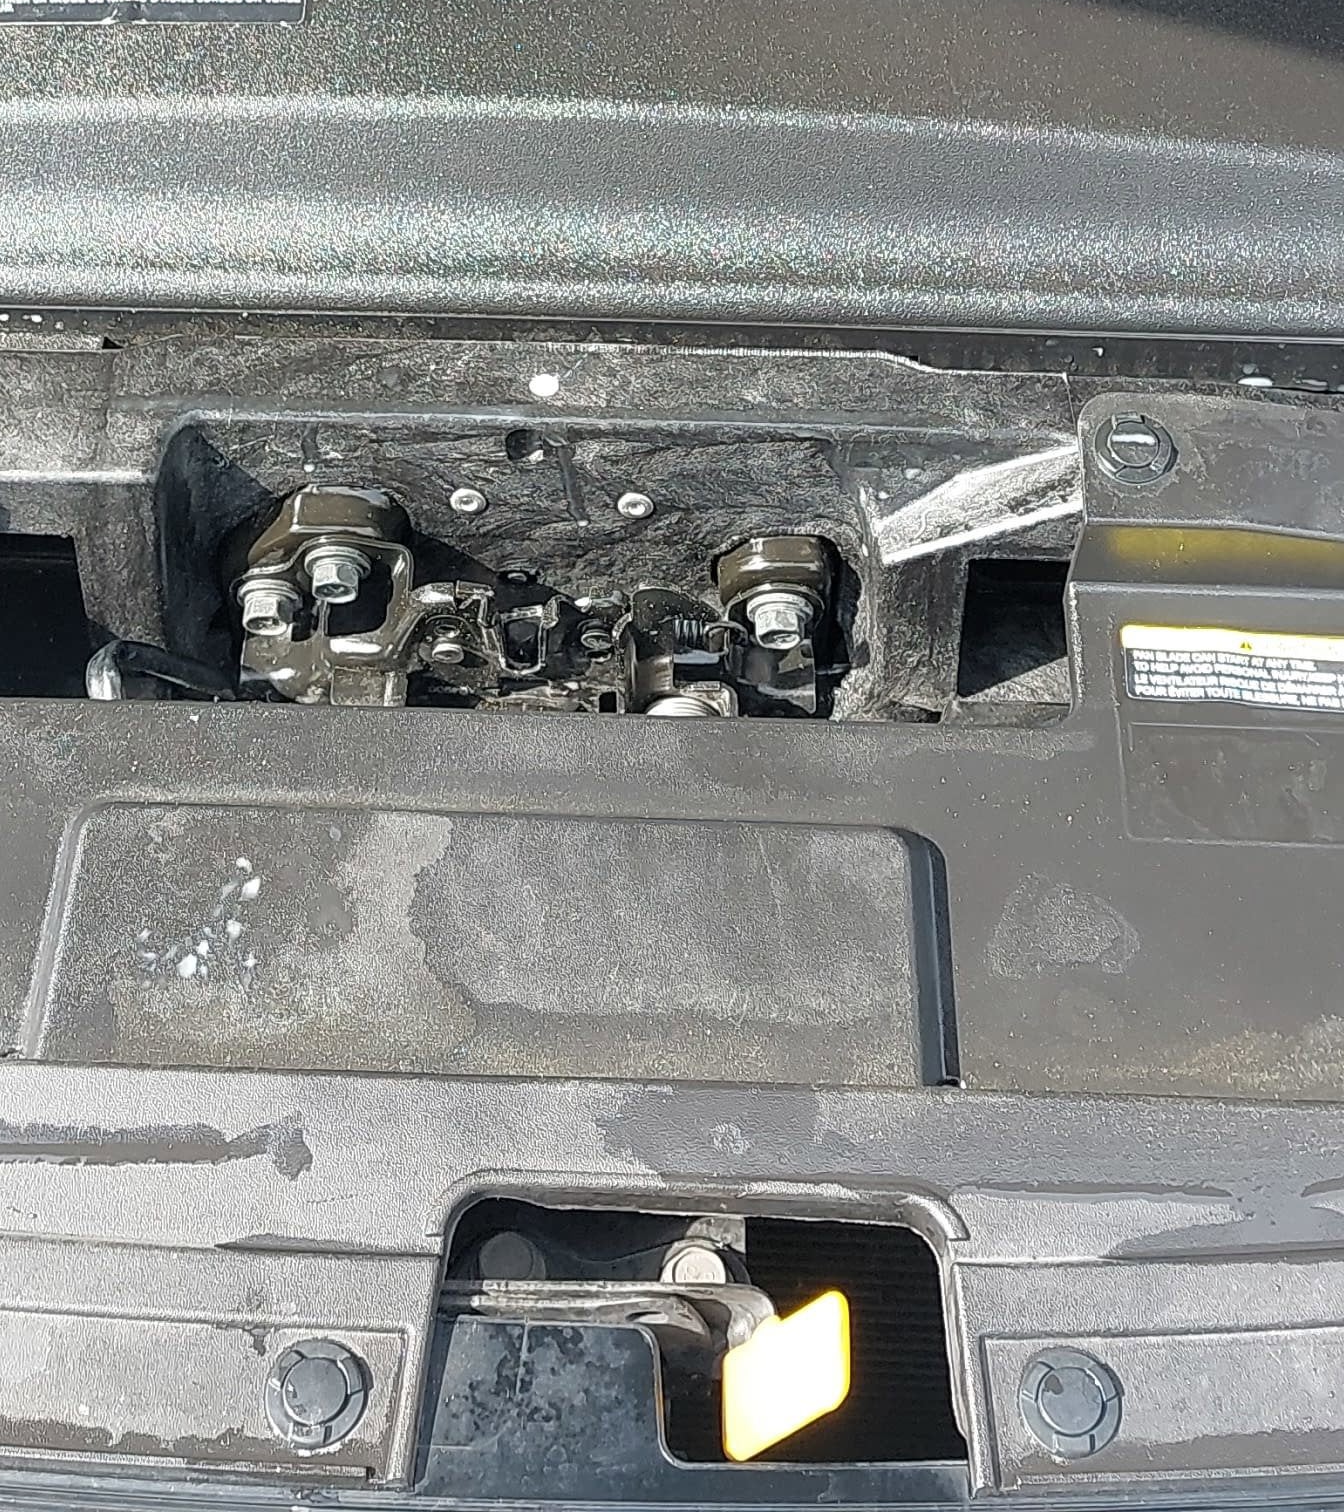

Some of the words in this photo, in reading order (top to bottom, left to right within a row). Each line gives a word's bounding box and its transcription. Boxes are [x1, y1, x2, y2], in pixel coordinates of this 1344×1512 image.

[1156, 651, 1190, 663] BLADE
[1191, 652, 1216, 663] CAN
[1217, 653, 1249, 666] START
[1251, 656, 1264, 667] AT
[1133, 661, 1149, 672] TO
[1150, 662, 1179, 673] HELP
[1179, 663, 1213, 674] AVOID
[1134, 673, 1148, 684] LE
[1135, 684, 1166, 696] POUR
[1205, 687, 1241, 700] TOUTE
